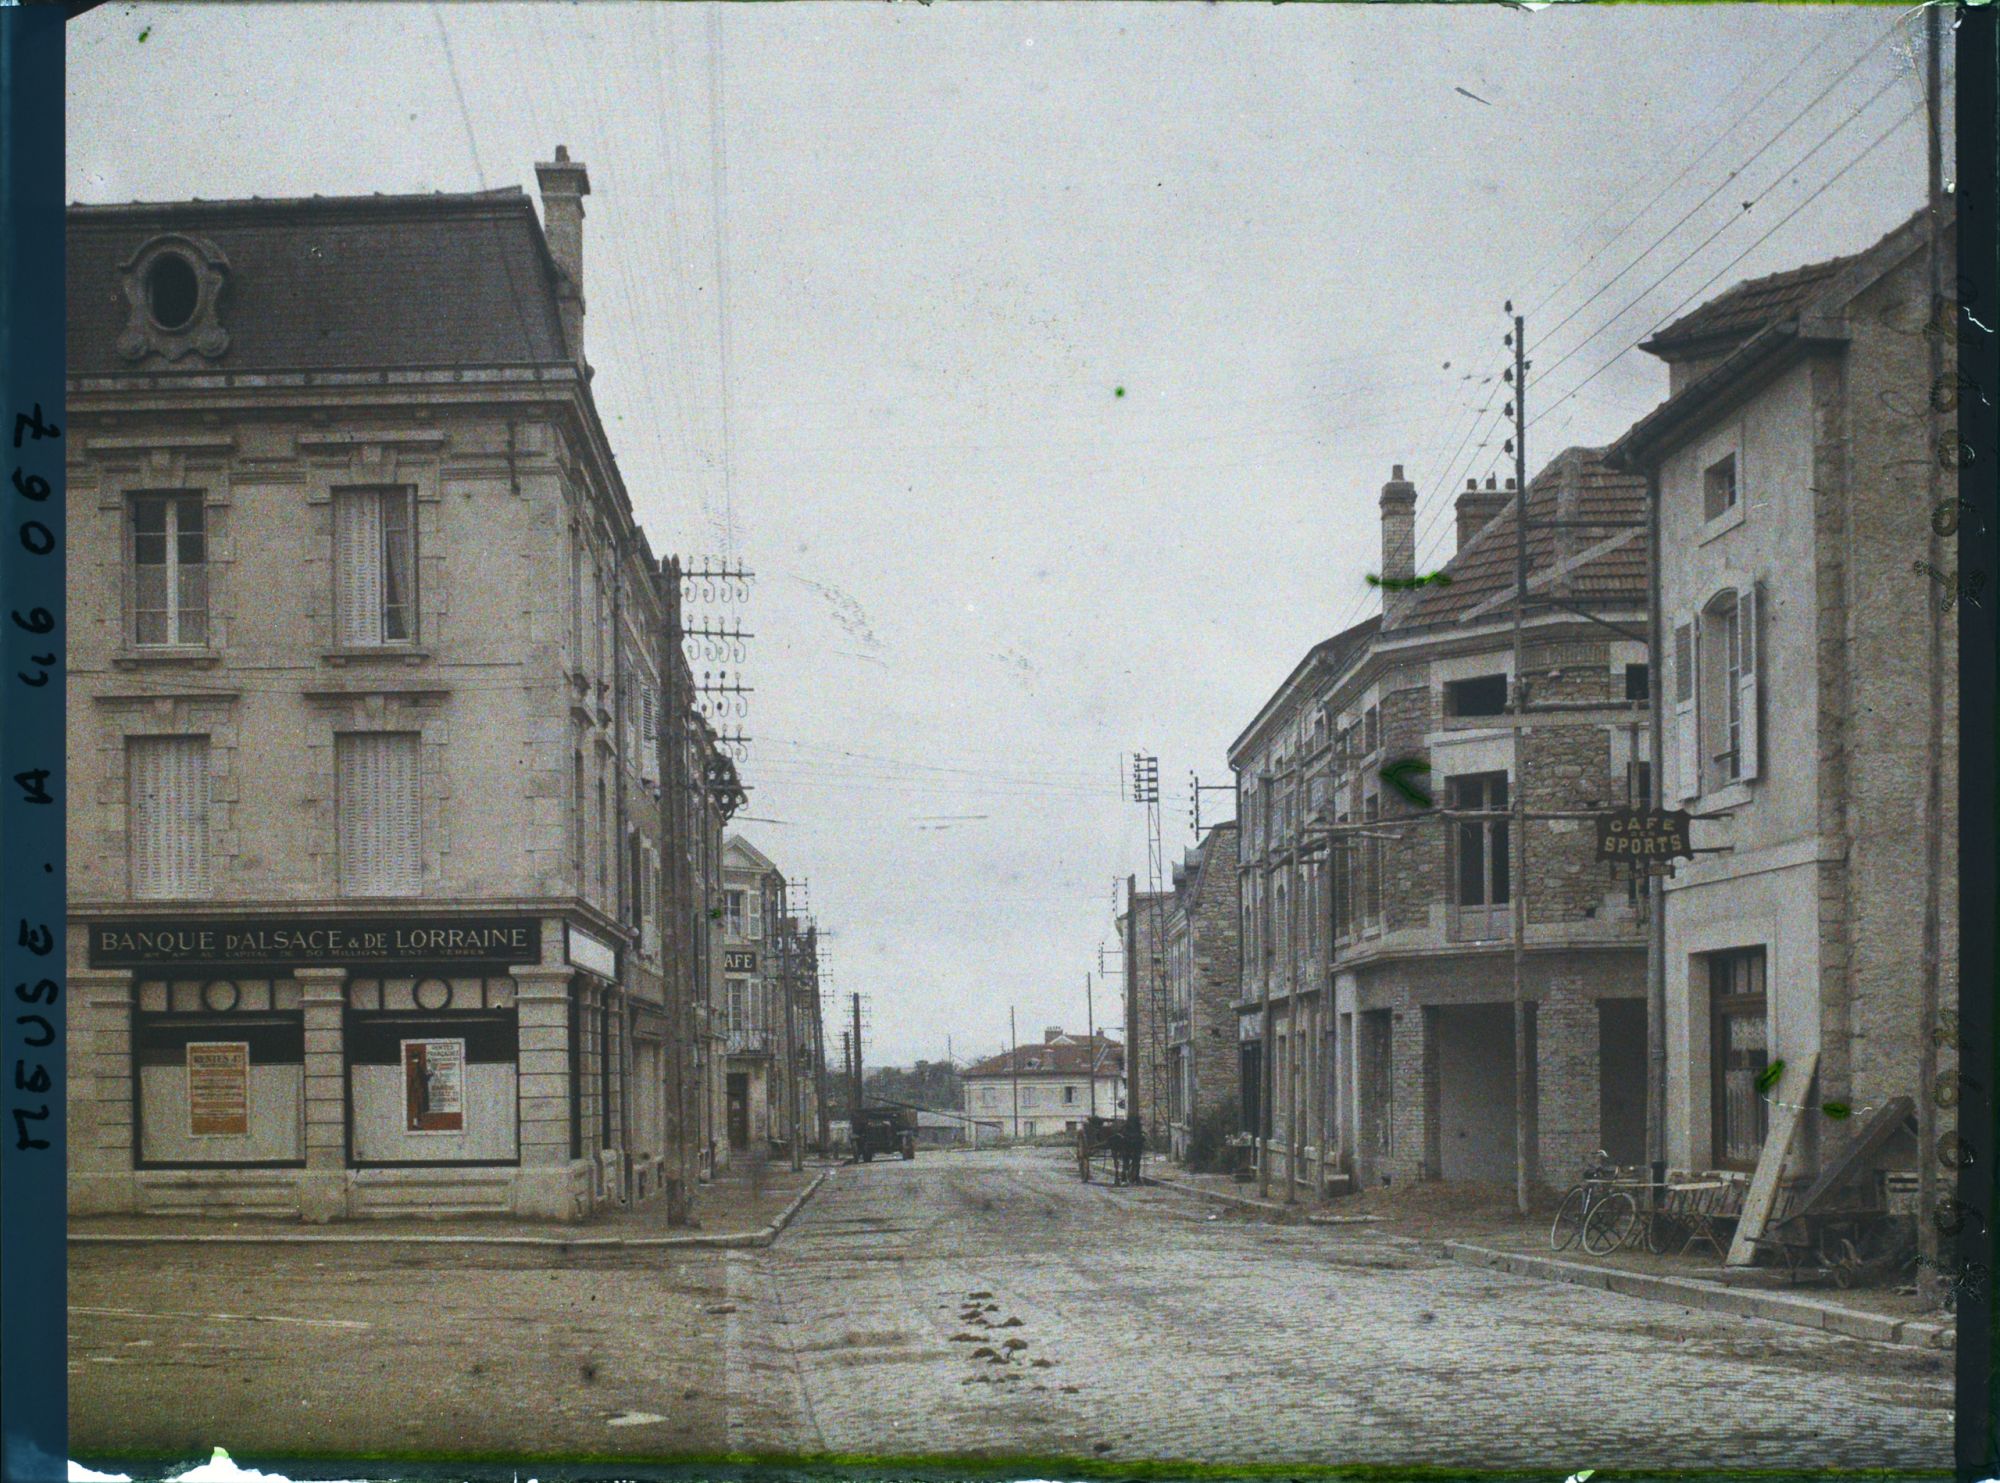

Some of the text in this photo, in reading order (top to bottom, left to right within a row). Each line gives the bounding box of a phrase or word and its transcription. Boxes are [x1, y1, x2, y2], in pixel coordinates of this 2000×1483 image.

[1604, 834, 1683, 854] SPORTS
[101, 929, 527, 952] BANQUE D'ALSACE & DE LORRAINE
[724, 953, 752, 968] AFE
[11, 918, 58, 1152] MEUSE
